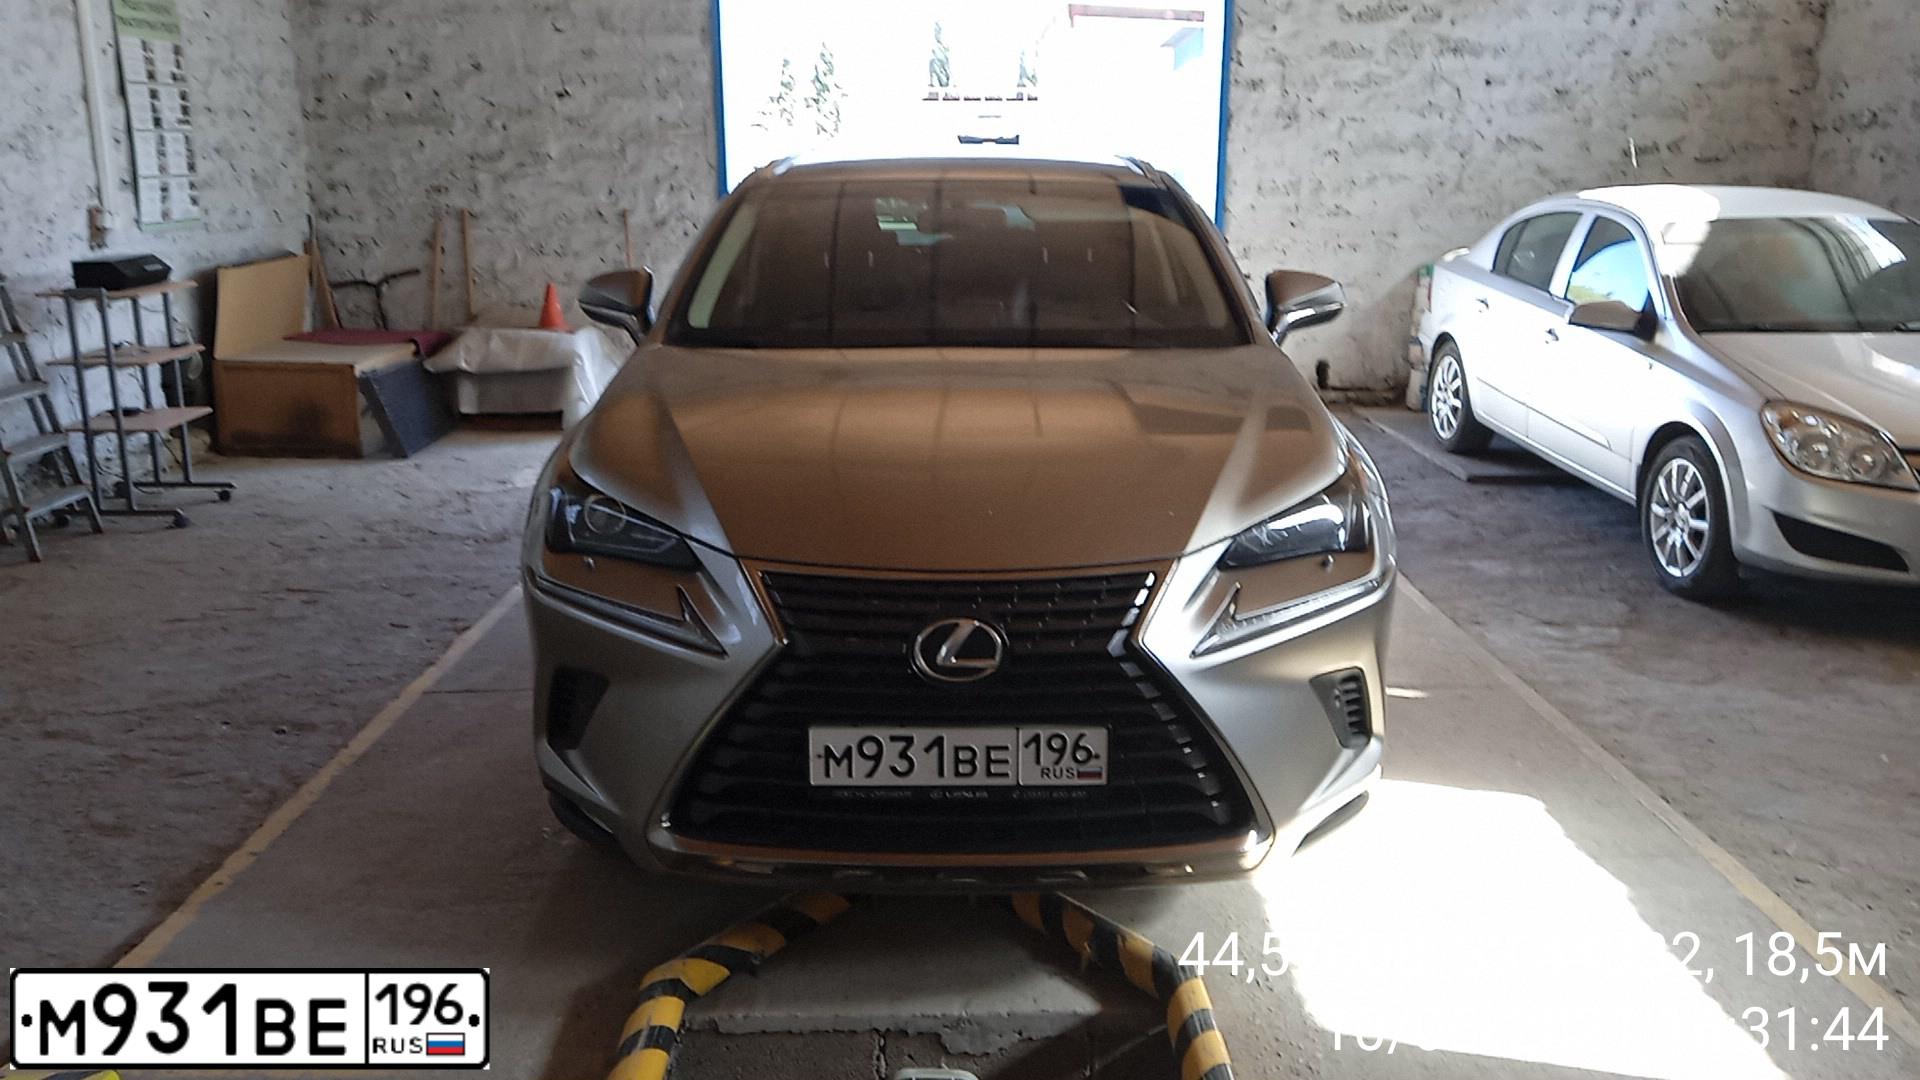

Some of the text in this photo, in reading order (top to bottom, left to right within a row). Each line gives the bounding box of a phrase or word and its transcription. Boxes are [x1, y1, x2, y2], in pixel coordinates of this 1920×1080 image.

[824, 732, 1094, 779] М931ВЕ 196
[1040, 767, 1076, 779] RUS
